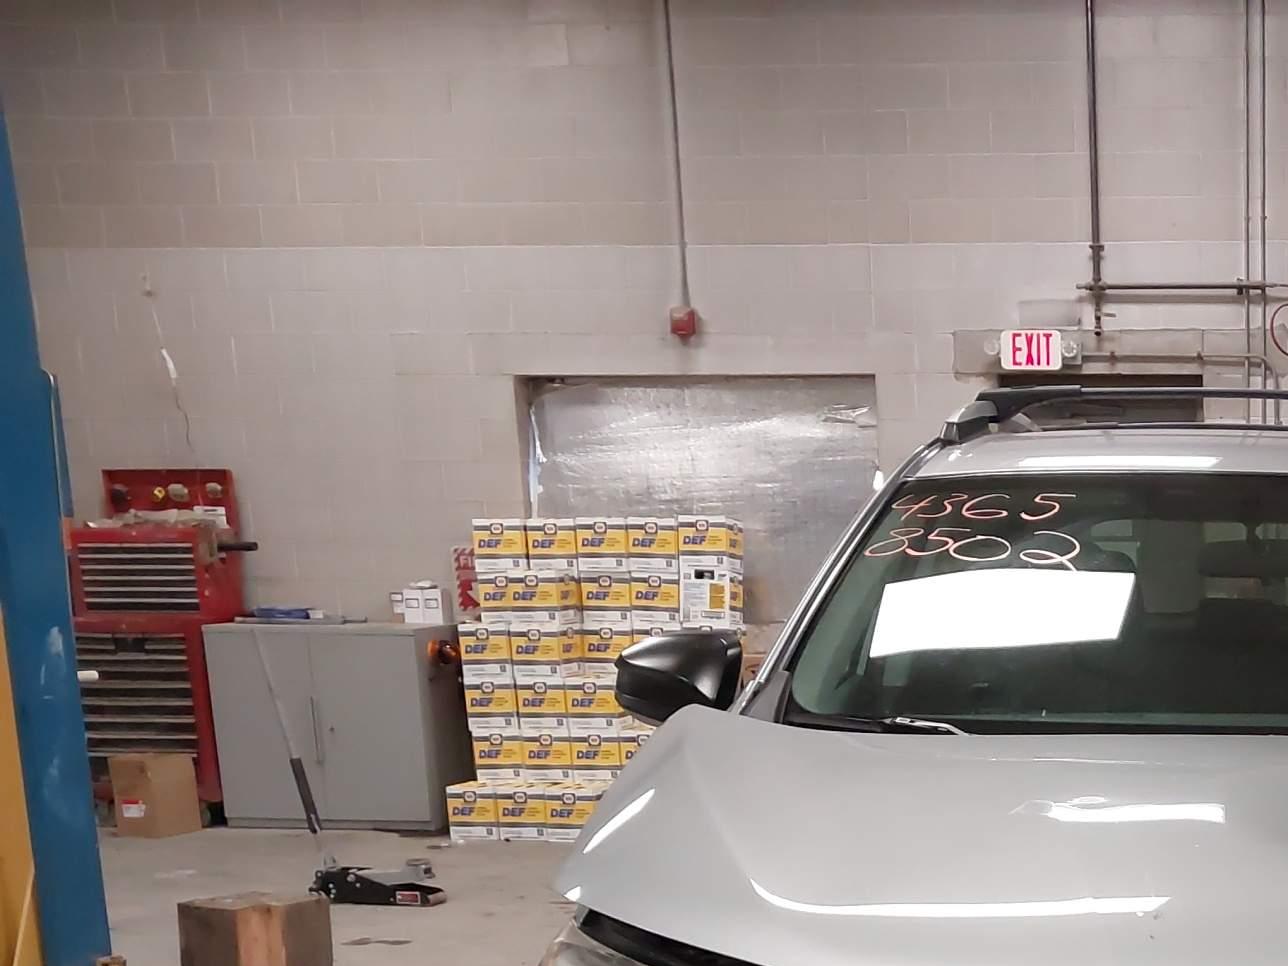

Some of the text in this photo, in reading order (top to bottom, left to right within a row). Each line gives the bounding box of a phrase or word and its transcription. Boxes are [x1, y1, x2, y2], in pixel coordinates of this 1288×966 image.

[1012, 333, 1052, 366] EXIT
[891, 493, 1077, 521] 4365
[478, 539, 502, 548] DEF
[532, 539, 555, 548] DEF
[581, 537, 605, 547] DEF
[632, 538, 656, 547] DEF
[683, 535, 707, 545] DEF
[863, 527, 1081, 572] 8502
[484, 591, 506, 601] DEF
[512, 591, 538, 601] DEF
[586, 591, 610, 600] DEF
[635, 591, 659, 600] DEF
[464, 644, 488, 654] DEF
[515, 645, 539, 654] DEF
[470, 698, 493, 707] DEF
[522, 698, 545, 707] DEF
[571, 698, 595, 708] DEF
[479, 750, 502, 759] DEF
[528, 750, 551, 759] DEF
[577, 750, 600, 759] DEF
[452, 806, 475, 816] DEF
[502, 806, 526, 817] DEF
[550, 808, 574, 818] DEF
